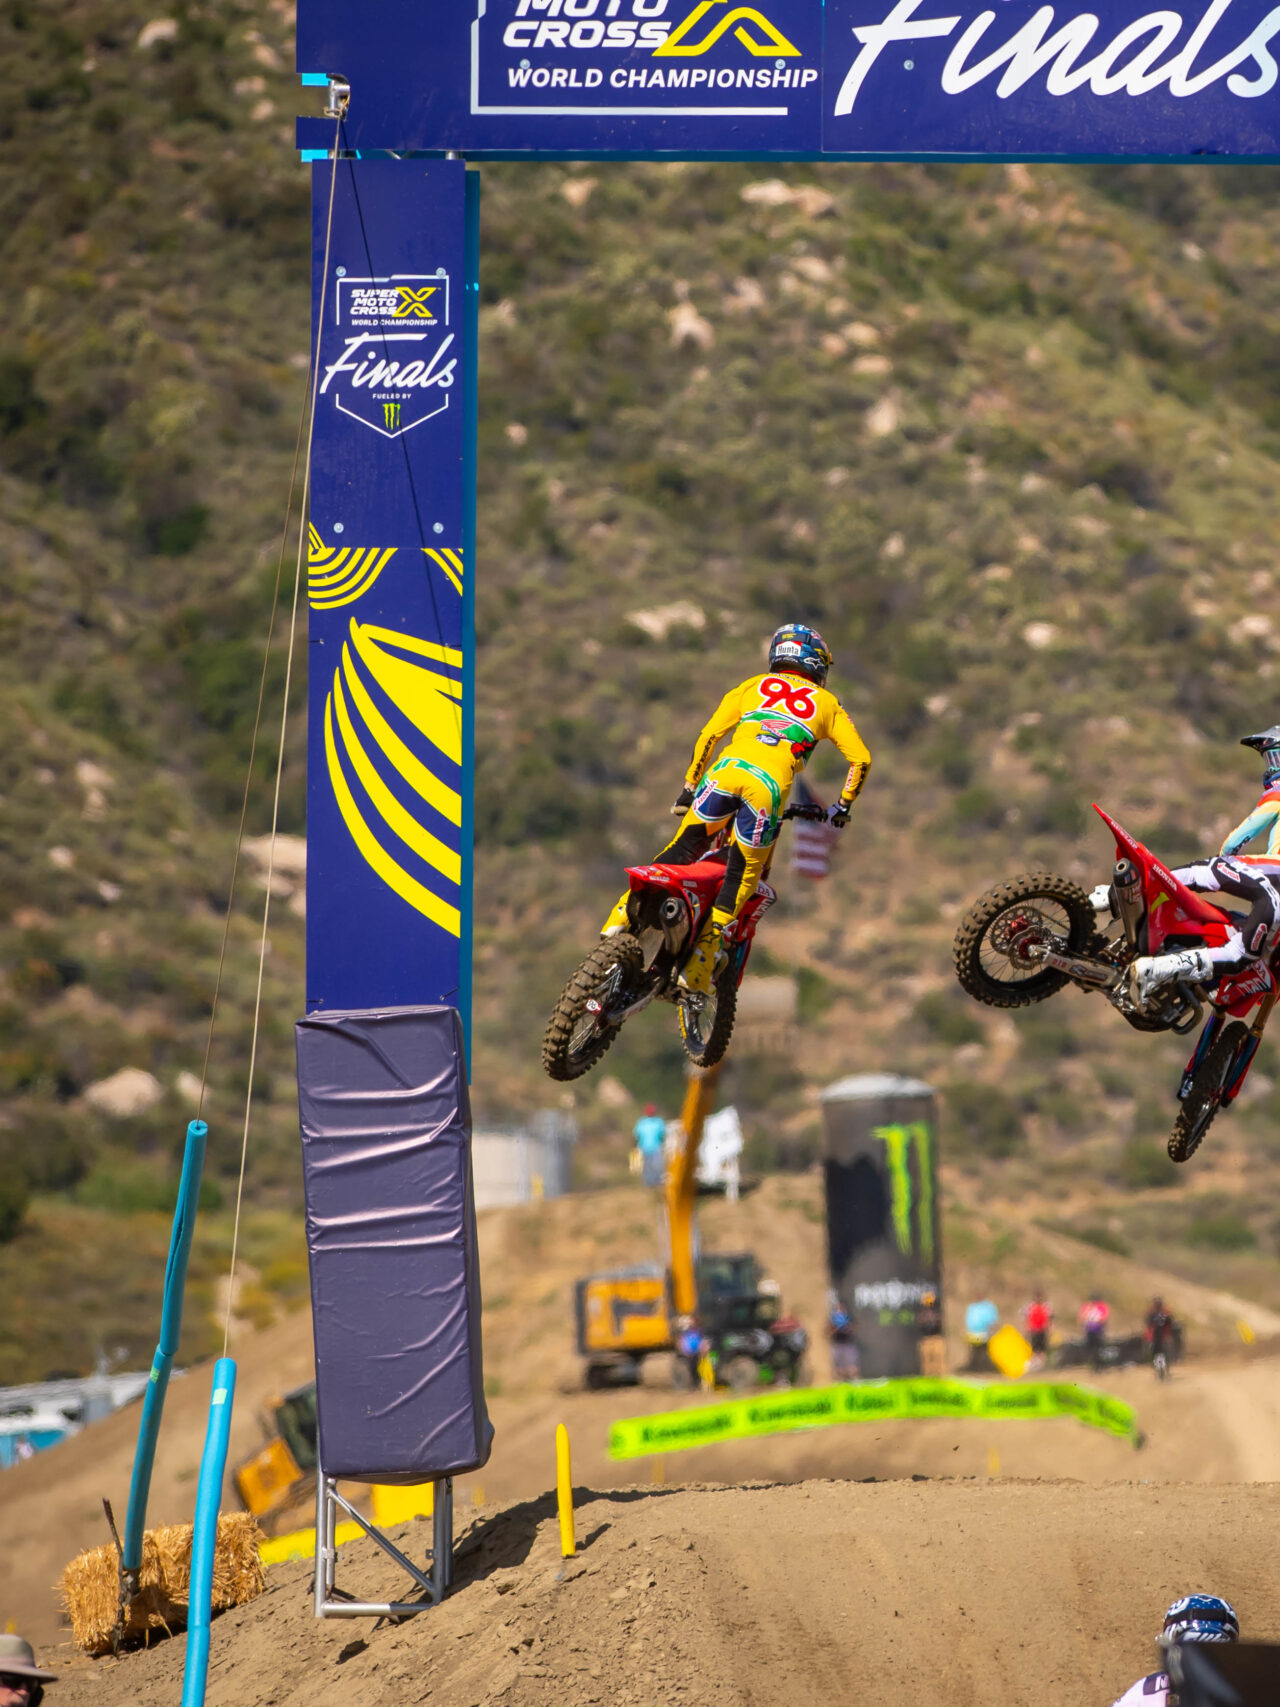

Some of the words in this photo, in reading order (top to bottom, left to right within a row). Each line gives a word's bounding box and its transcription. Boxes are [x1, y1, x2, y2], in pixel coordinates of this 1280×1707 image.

[503, 20, 672, 48] CROSS
[508, 67, 603, 88] WORLD
[610, 67, 818, 88] CHAMPIONSHIP
[351, 289, 399, 298] SUPER
[354, 298, 397, 306] MOTO
[350, 306, 397, 315] CROSS
[320, 331, 457, 394] Finals
[759, 677, 817, 721] 96
[1152, 863, 1178, 891] HONDA
